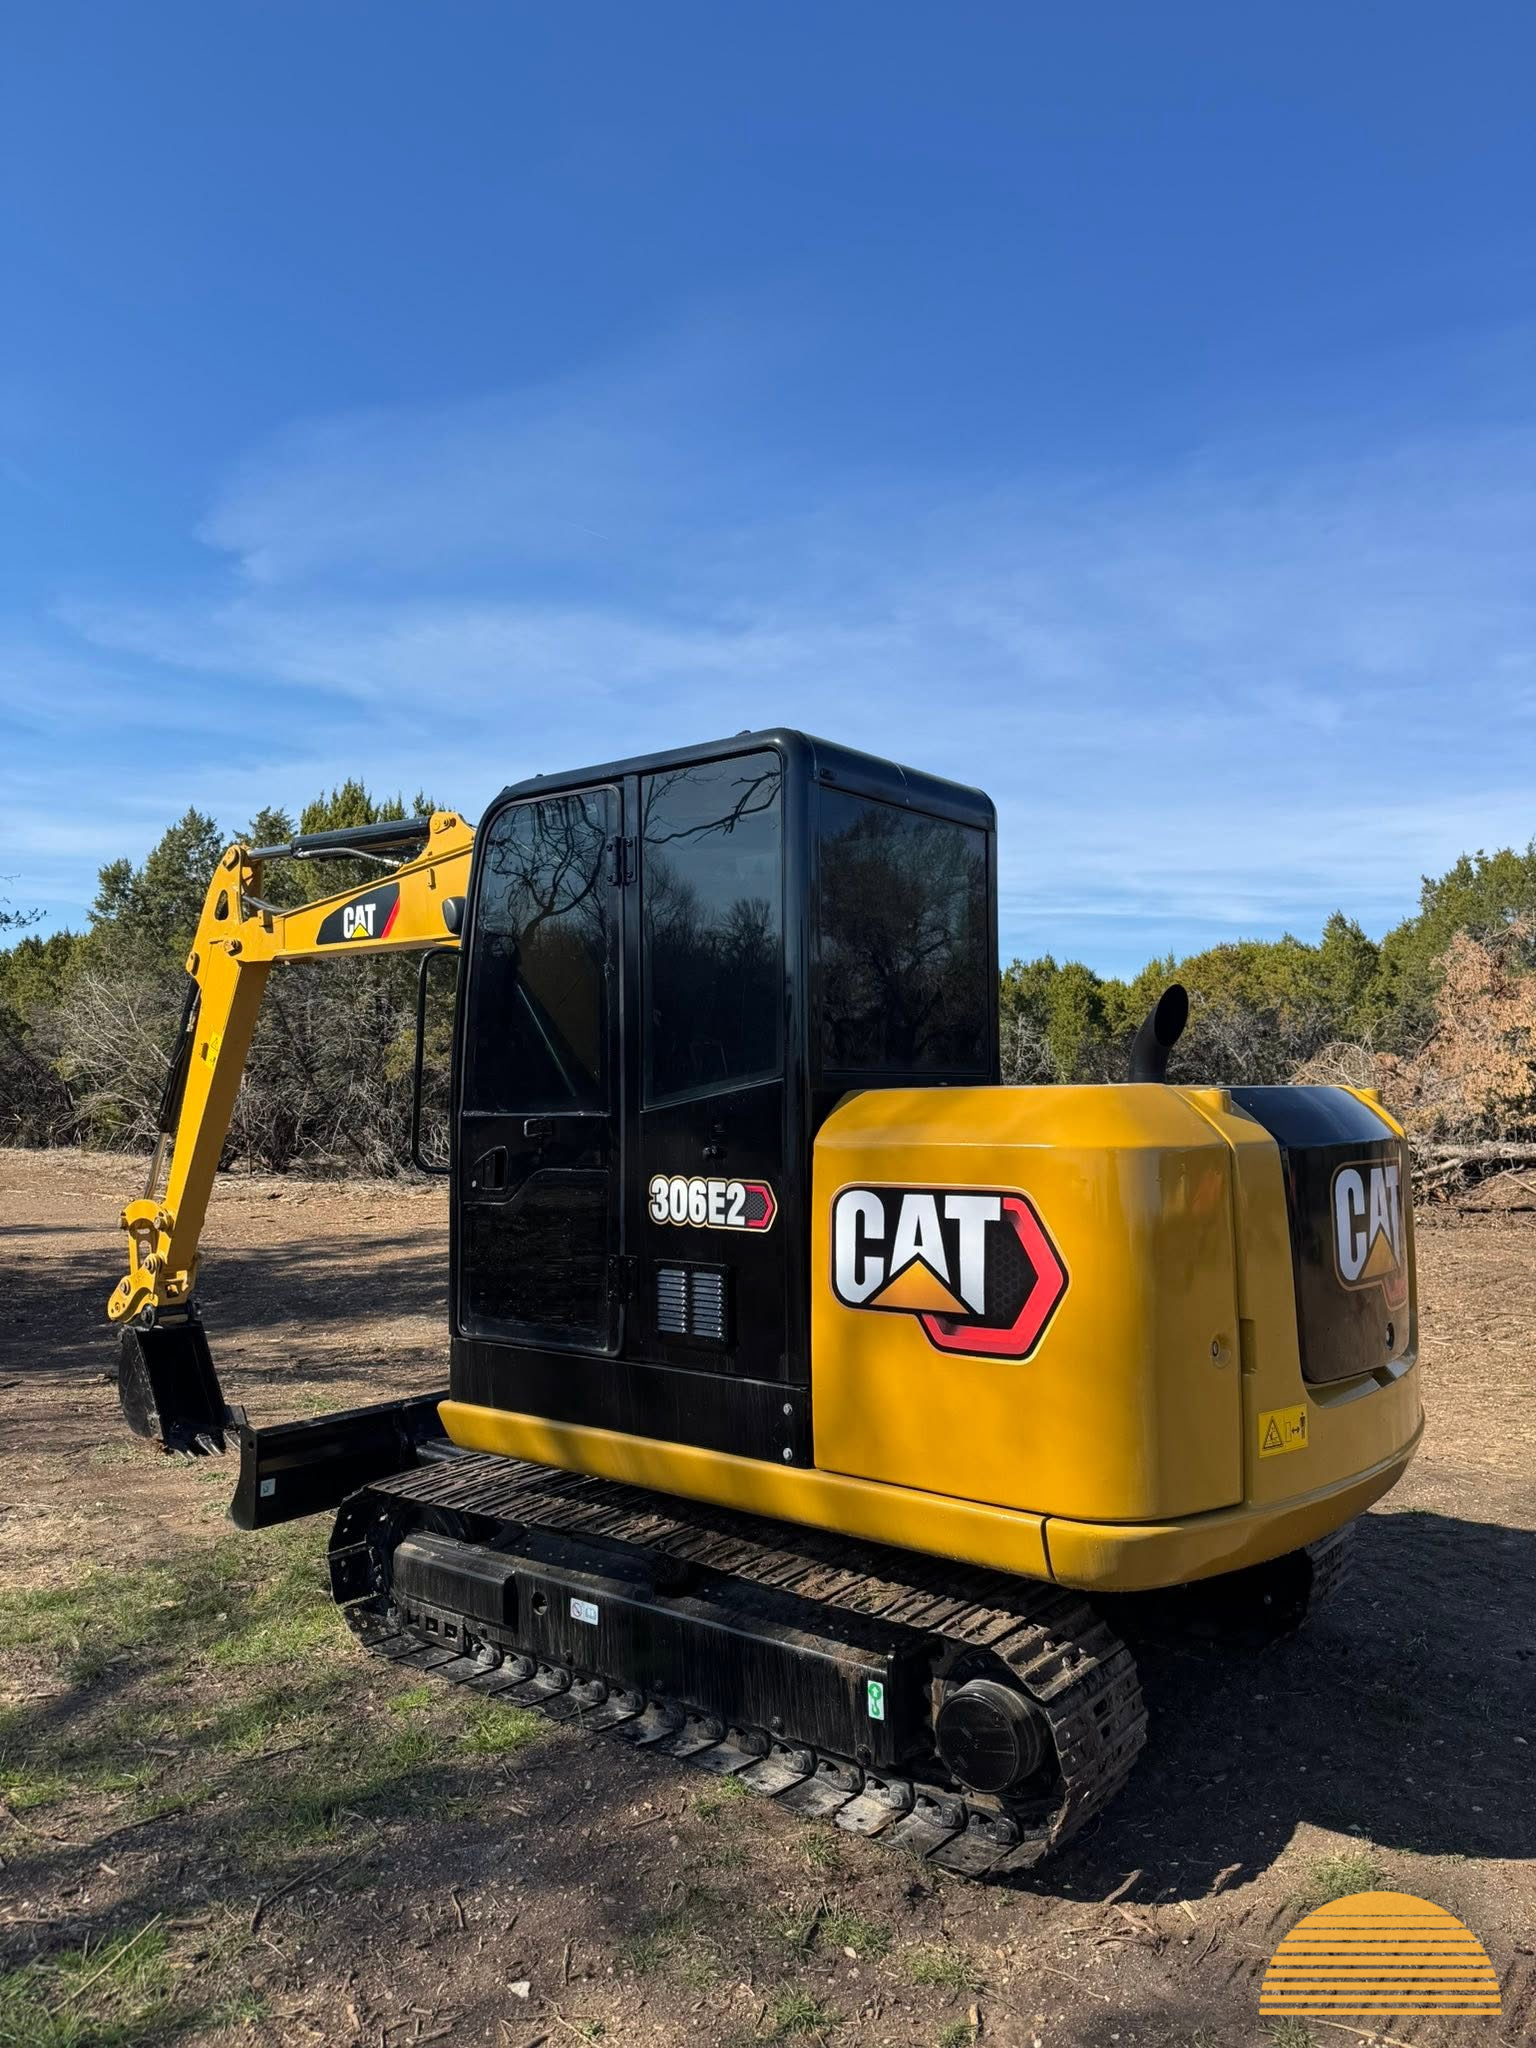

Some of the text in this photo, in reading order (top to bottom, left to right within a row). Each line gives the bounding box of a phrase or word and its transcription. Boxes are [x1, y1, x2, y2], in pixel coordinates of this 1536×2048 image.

[343, 903, 376, 939] CAT
[651, 1178, 746, 1226] 306E2
[1335, 1165, 1400, 1281] CAT
[835, 1190, 1001, 1315] CAT
